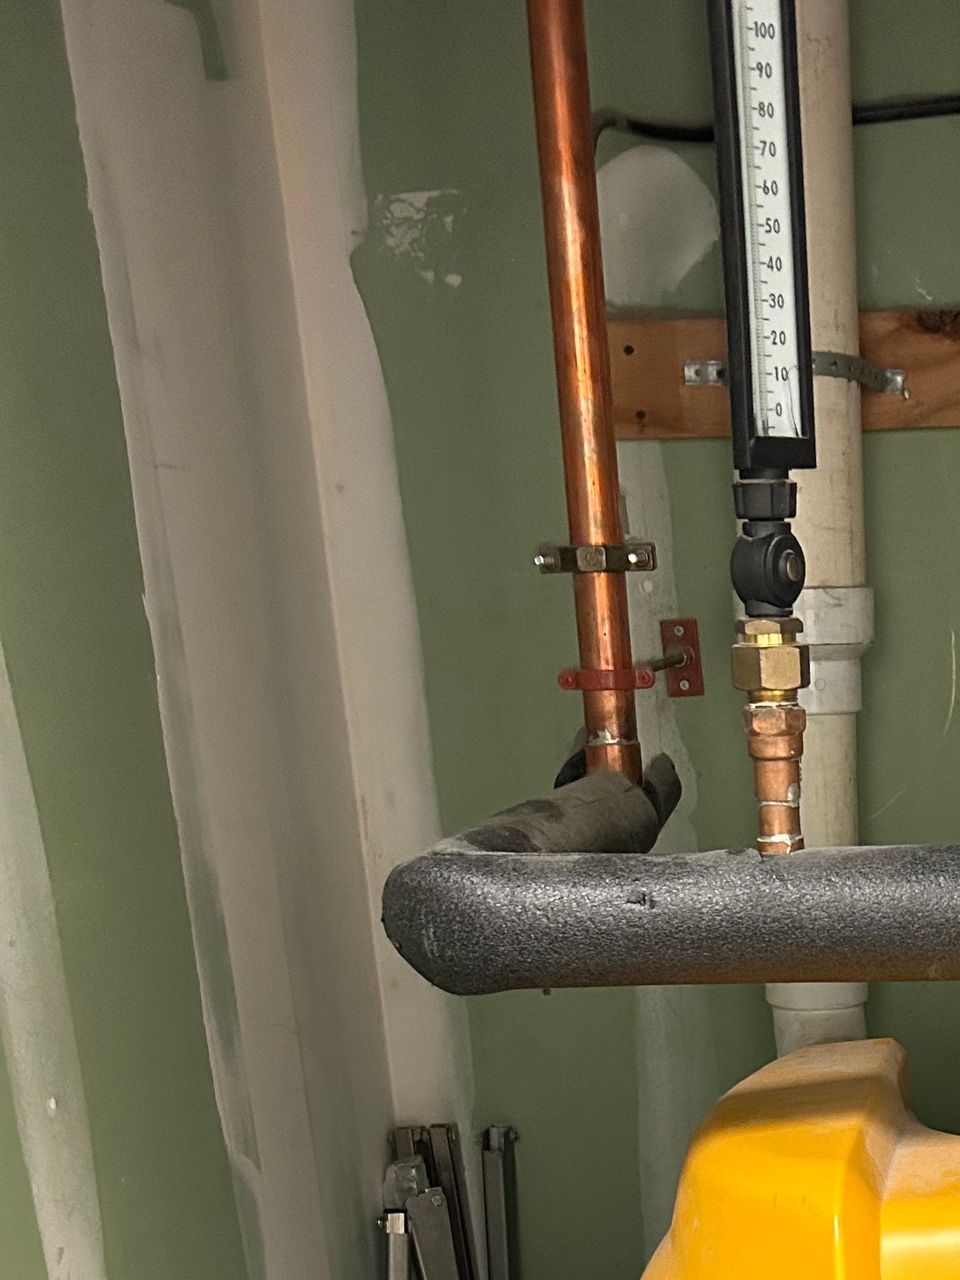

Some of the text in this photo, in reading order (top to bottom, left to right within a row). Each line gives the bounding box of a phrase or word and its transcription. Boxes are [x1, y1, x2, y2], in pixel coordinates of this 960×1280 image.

[754, 24, 775, 40] 100
[756, 63, 773, 79] 90
[758, 103, 774, 119] 80
[760, 142, 776, 157] 70
[762, 180, 778, 196] 60
[764, 219, 780, 234] 50
[766, 257, 782, 272] 40
[768, 294, 784, 309] 30
[770, 331, 786, 345] 20
[773, 367, 788, 381] 10
[775, 404, 783, 417] 0
